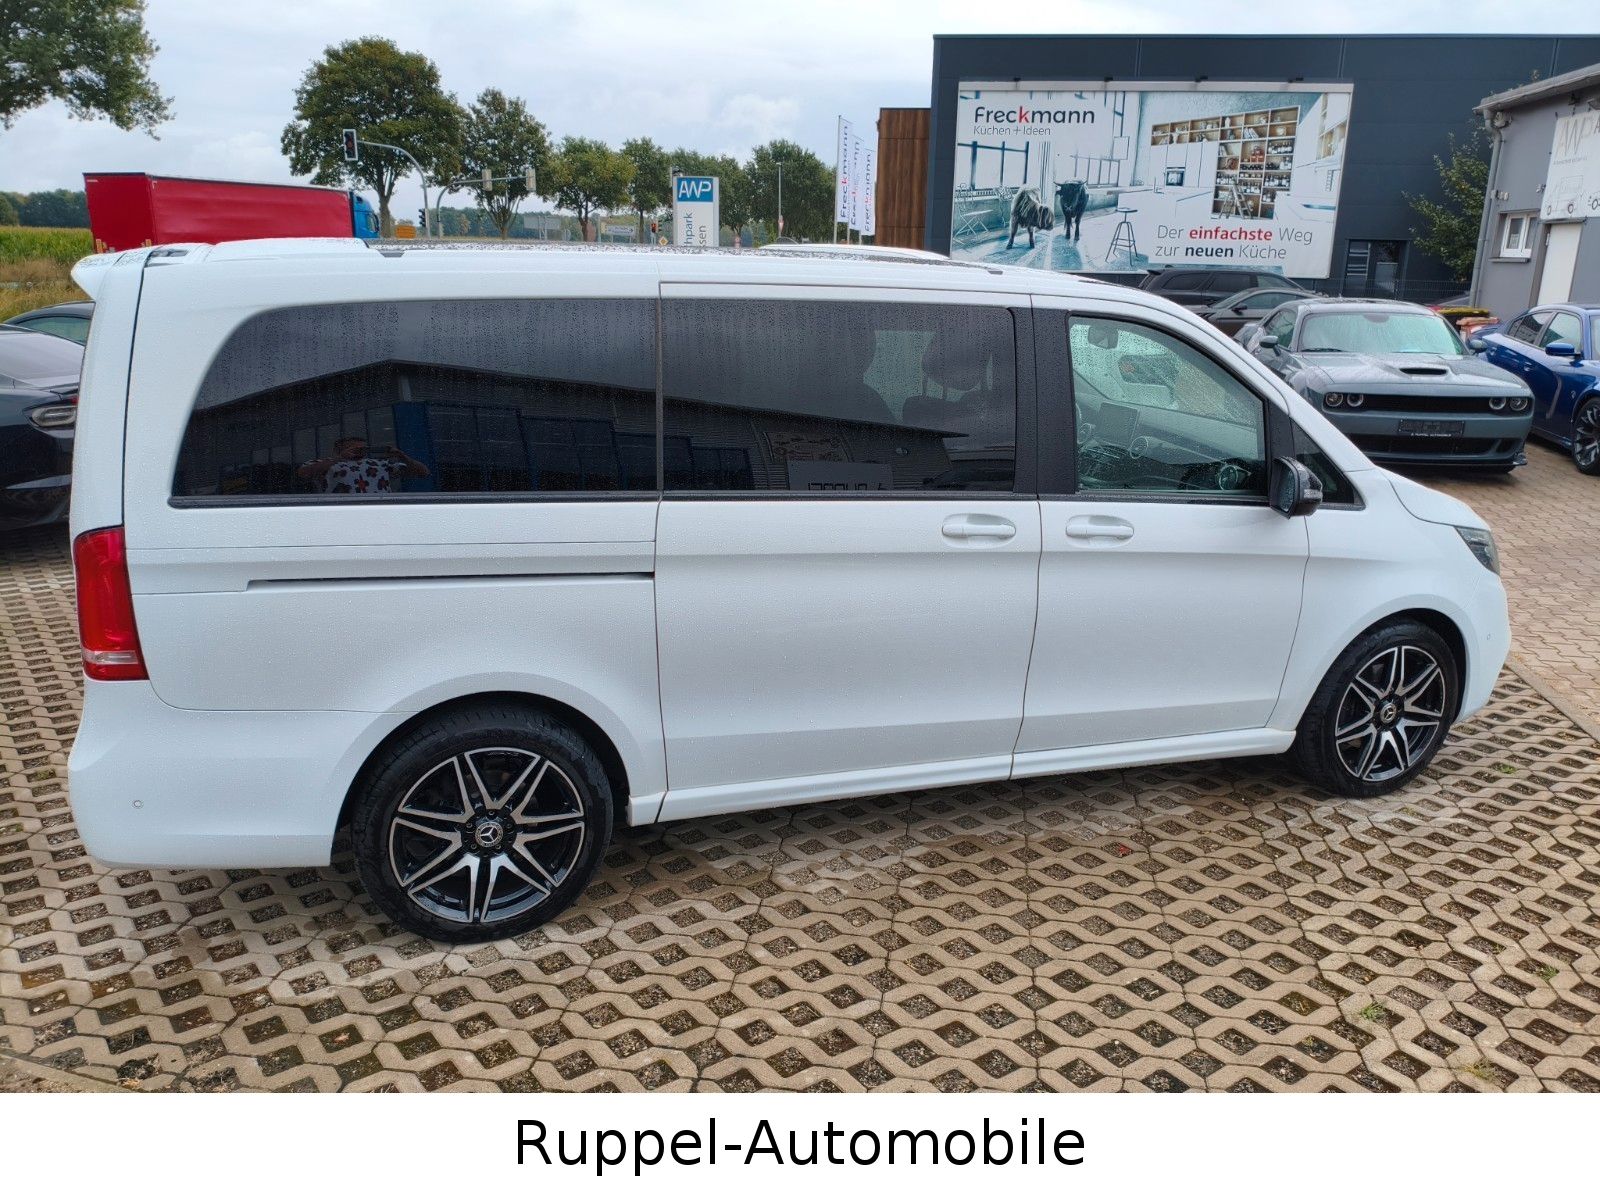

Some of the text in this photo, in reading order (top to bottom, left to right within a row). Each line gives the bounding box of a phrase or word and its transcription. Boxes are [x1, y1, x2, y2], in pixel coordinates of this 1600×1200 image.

[974, 106, 1095, 124] Freckmann
[1023, 126, 1051, 136] Ideen
[678, 180, 712, 199] AWP
[1157, 225, 1314, 246] Der einfachste Weg
[1155, 245, 1288, 260] zur neuen Küche
